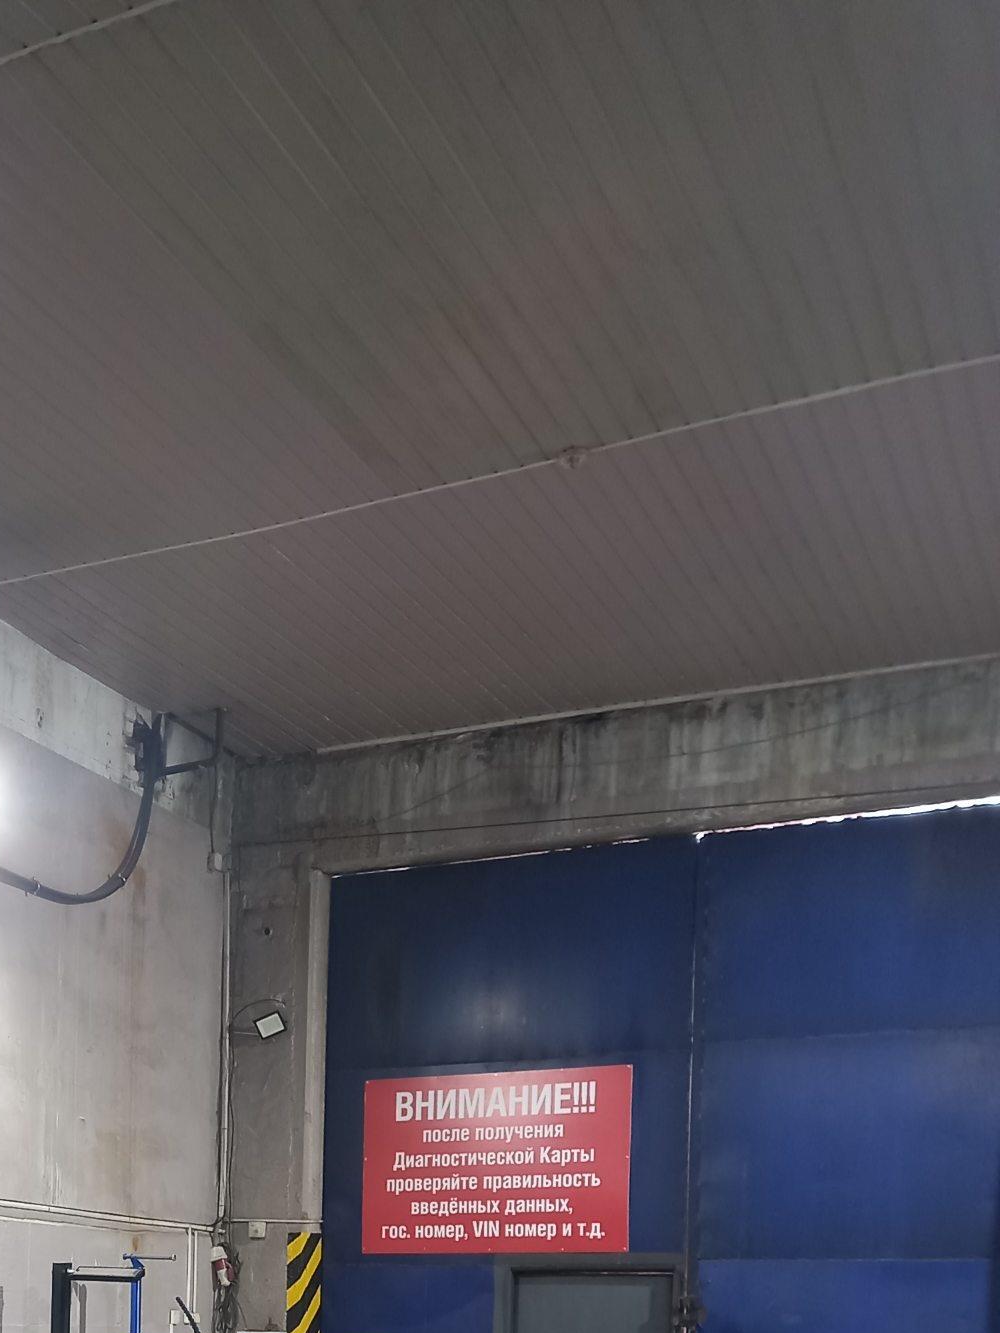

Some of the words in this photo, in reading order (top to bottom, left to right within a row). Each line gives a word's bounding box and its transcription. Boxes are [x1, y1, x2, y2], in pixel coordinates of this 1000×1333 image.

[395, 1081, 597, 1122] ВНИМАНИЕ!!!
[422, 1126, 470, 1143] после
[475, 1123, 564, 1144] получения
[393, 1147, 535, 1171] Диагностической
[539, 1147, 595, 1169] Карты
[386, 1172, 478, 1195] проверяйте
[483, 1172, 601, 1192] правильность
[411, 1197, 500, 1216] введённых
[504, 1197, 573, 1216] данных,
[381, 1224, 411, 1240] гос.
[415, 1222, 468, 1242] номер,
[473, 1221, 500, 1238] VIN
[504, 1222, 556, 1241] номер
[561, 1222, 572, 1237] и
[576, 1222, 606, 1240] т.д.
